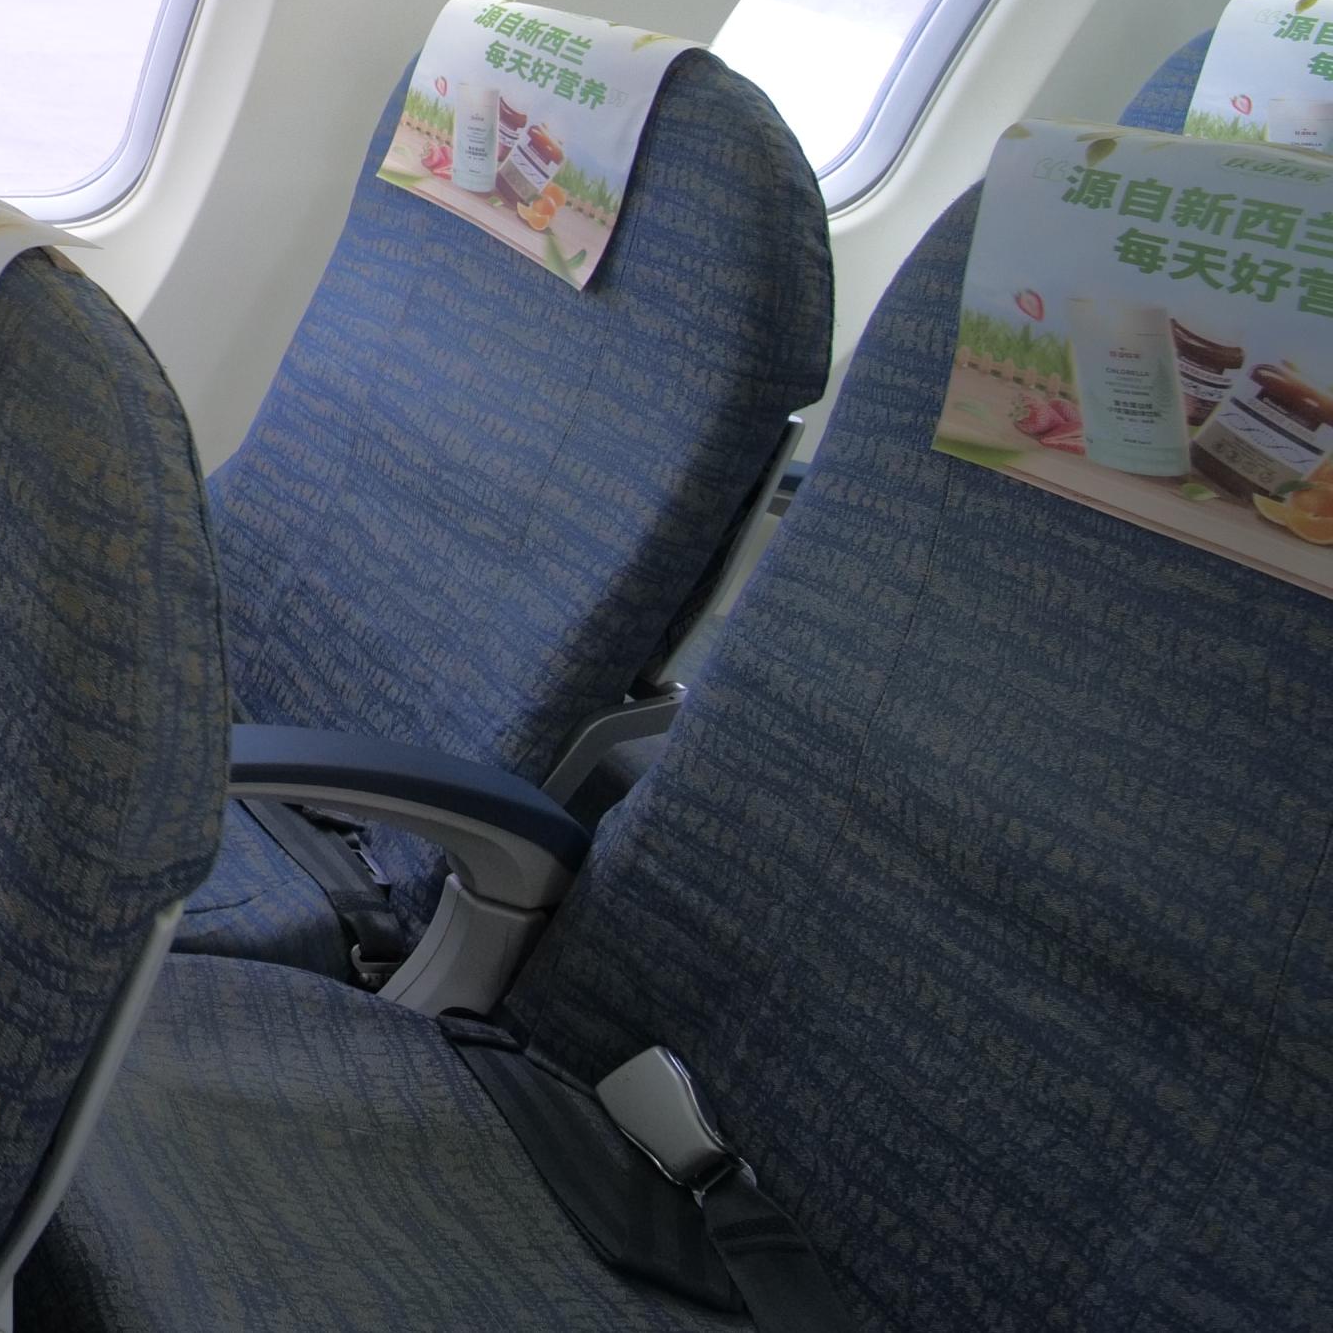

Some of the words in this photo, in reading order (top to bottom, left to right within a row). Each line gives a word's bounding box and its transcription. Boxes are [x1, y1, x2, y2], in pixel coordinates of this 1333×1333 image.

[473, 3, 593, 66] 源自新西兰
[484, 40, 608, 110] 每天好营养
